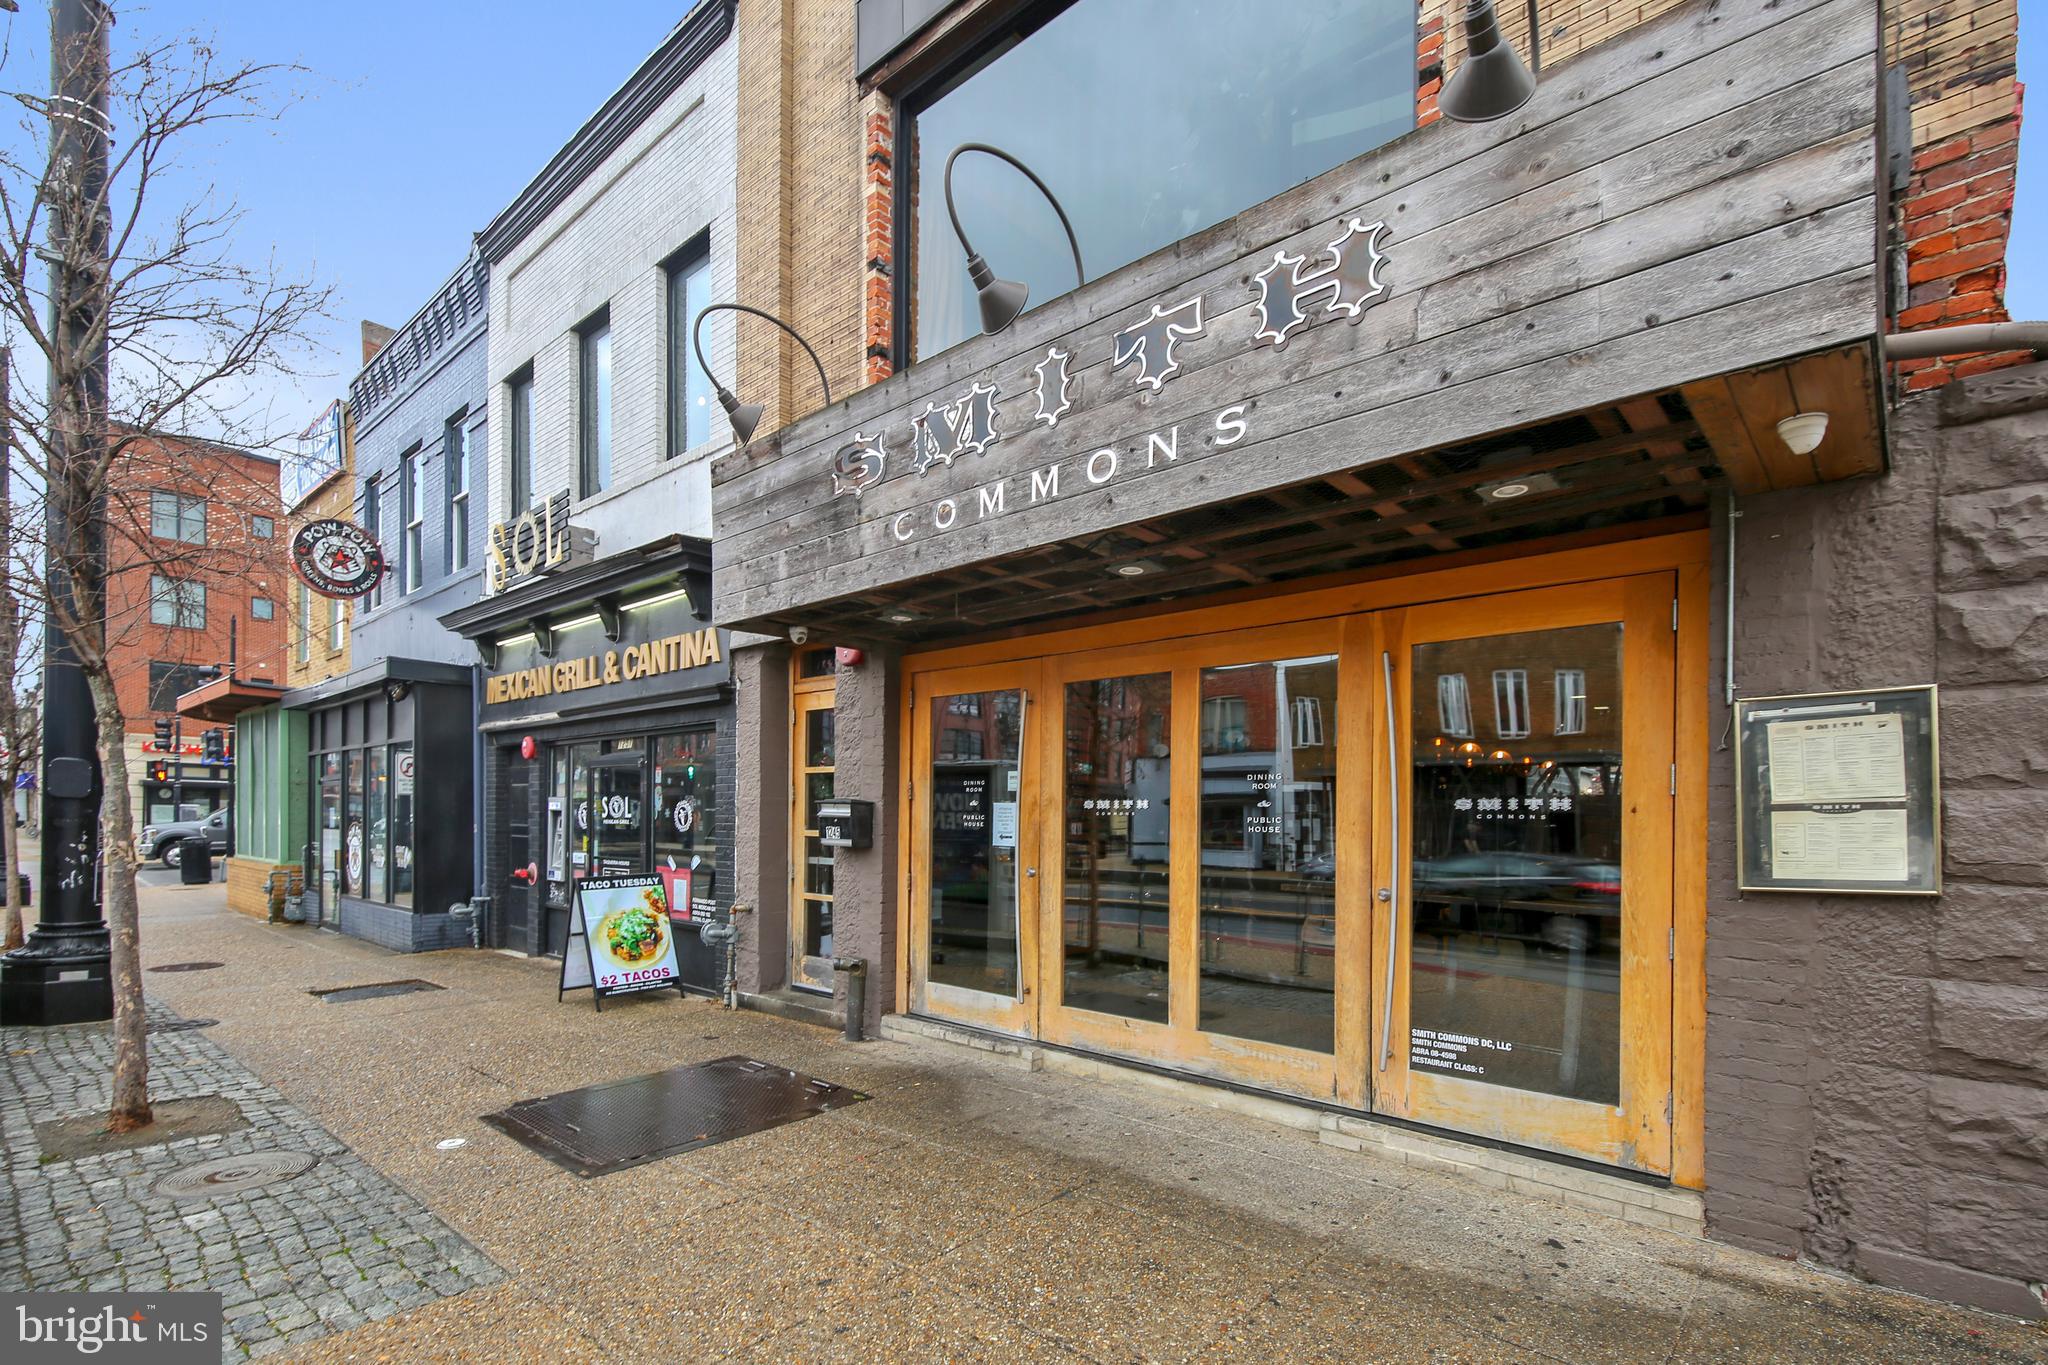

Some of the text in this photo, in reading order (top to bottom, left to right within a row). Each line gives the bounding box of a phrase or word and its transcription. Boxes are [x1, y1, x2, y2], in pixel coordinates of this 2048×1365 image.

[831, 218, 1392, 498] SMITH
[894, 406, 1247, 542] COMMONS
[303, 522, 376, 553] POW POW
[492, 496, 562, 590] SOL
[486, 626, 721, 705] MEXICAN GRILL & CANTINA
[601, 795, 632, 818] SOL
[1083, 799, 1149, 810] SMITH
[1453, 797, 1572, 811] SMITH
[580, 877, 660, 890] TACO TUESDAY
[601, 974, 619, 985] $2
[621, 967, 670, 982] TACOS
[1411, 1028, 1512, 1051] SMITH COMMONS DC, LLC
[1411, 1038, 1467, 1052] SMITH COMMONS
[1411, 1047, 1429, 1056] ABRA
[1411, 1056, 1484, 1074] RESTAURANT CLASS: C
